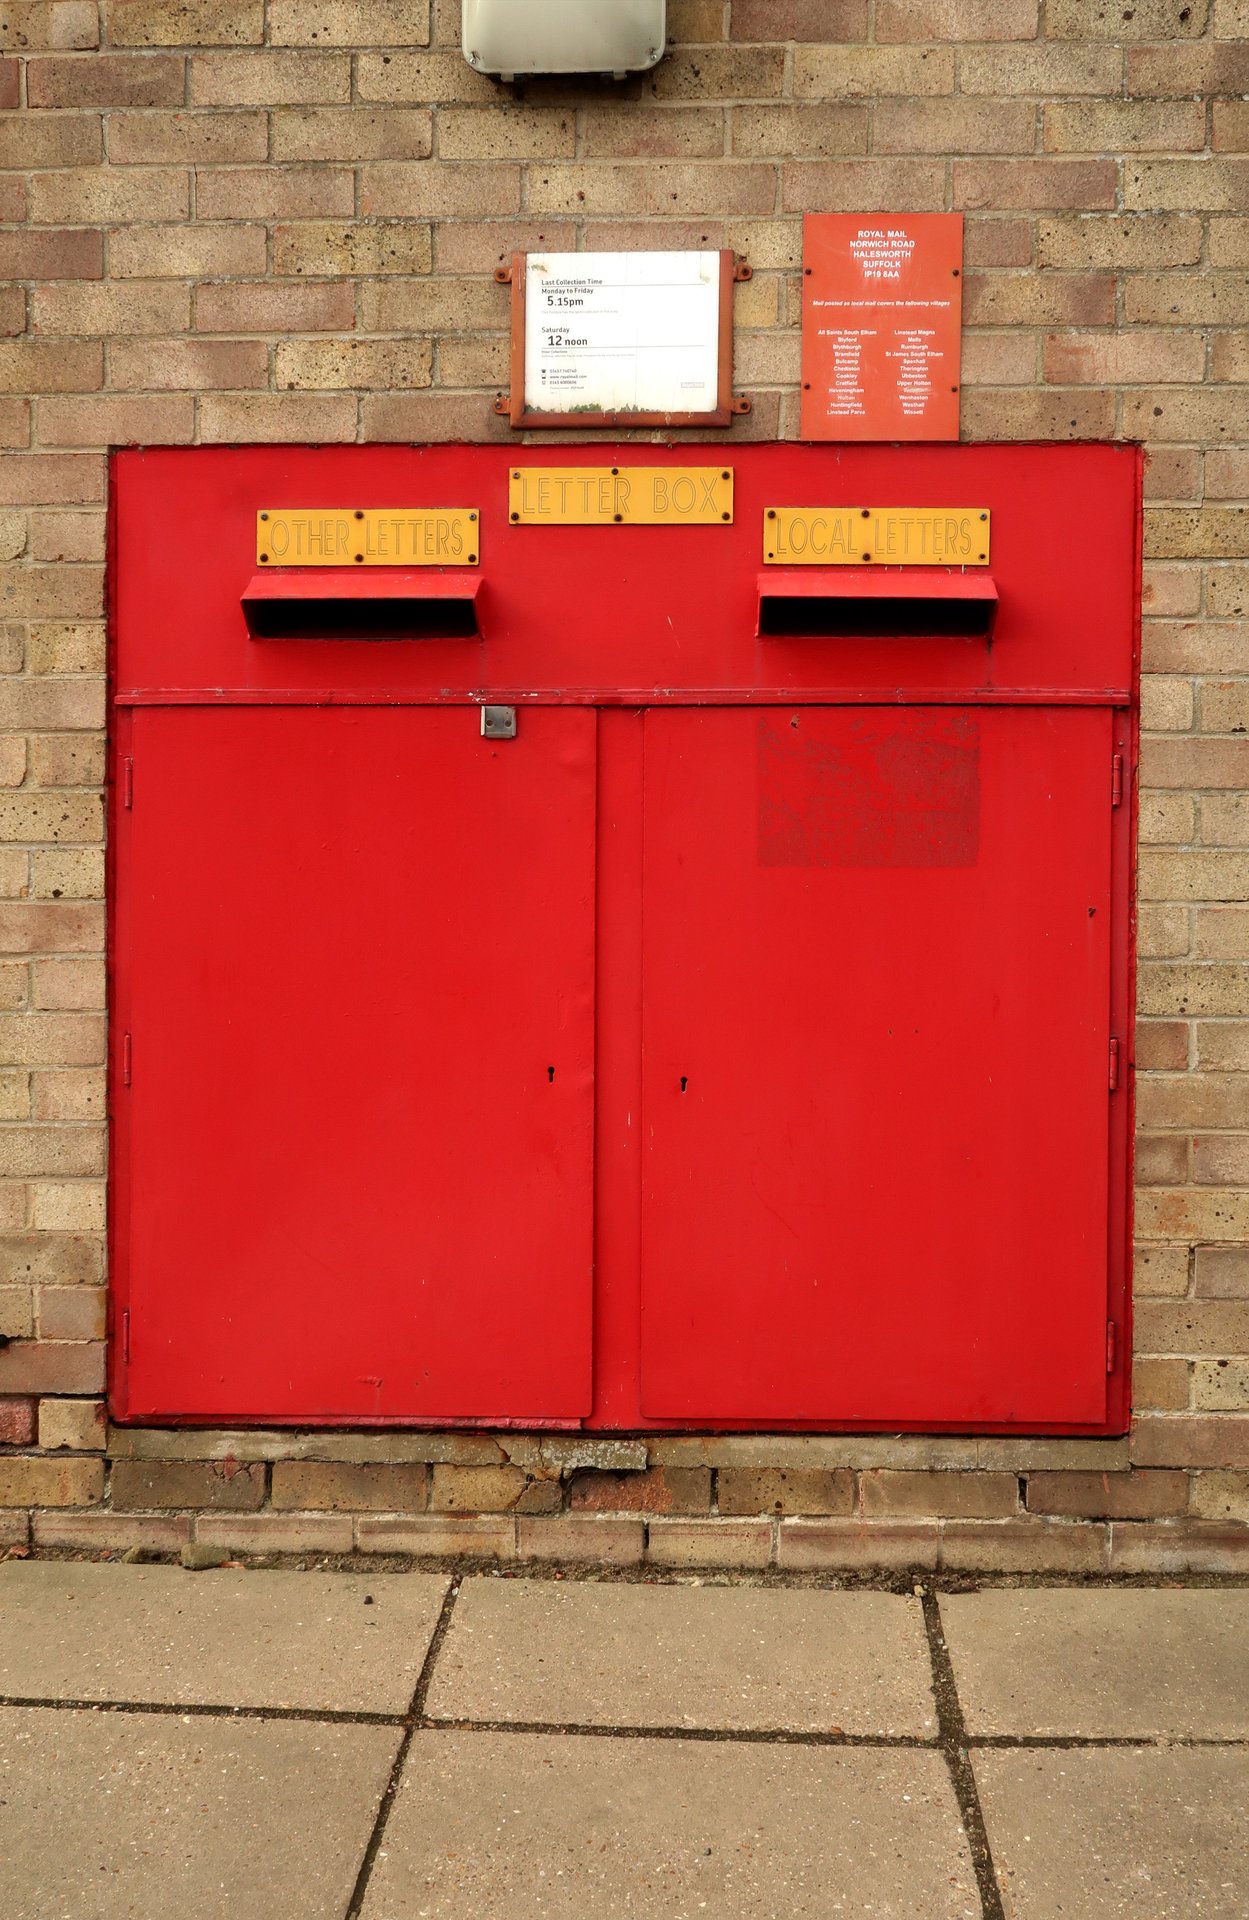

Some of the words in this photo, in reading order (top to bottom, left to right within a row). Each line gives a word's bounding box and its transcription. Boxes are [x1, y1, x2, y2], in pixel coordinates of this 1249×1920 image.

[547, 295, 584, 307] 5.15pm
[548, 335, 562, 346] 12
[522, 476, 632, 514] LETTER
[652, 476, 719, 514] BOX
[270, 519, 350, 557] OTHER
[365, 519, 463, 556] LETTERS
[776, 517, 858, 554] LOCAL
[875, 518, 972, 555] LETTERS
